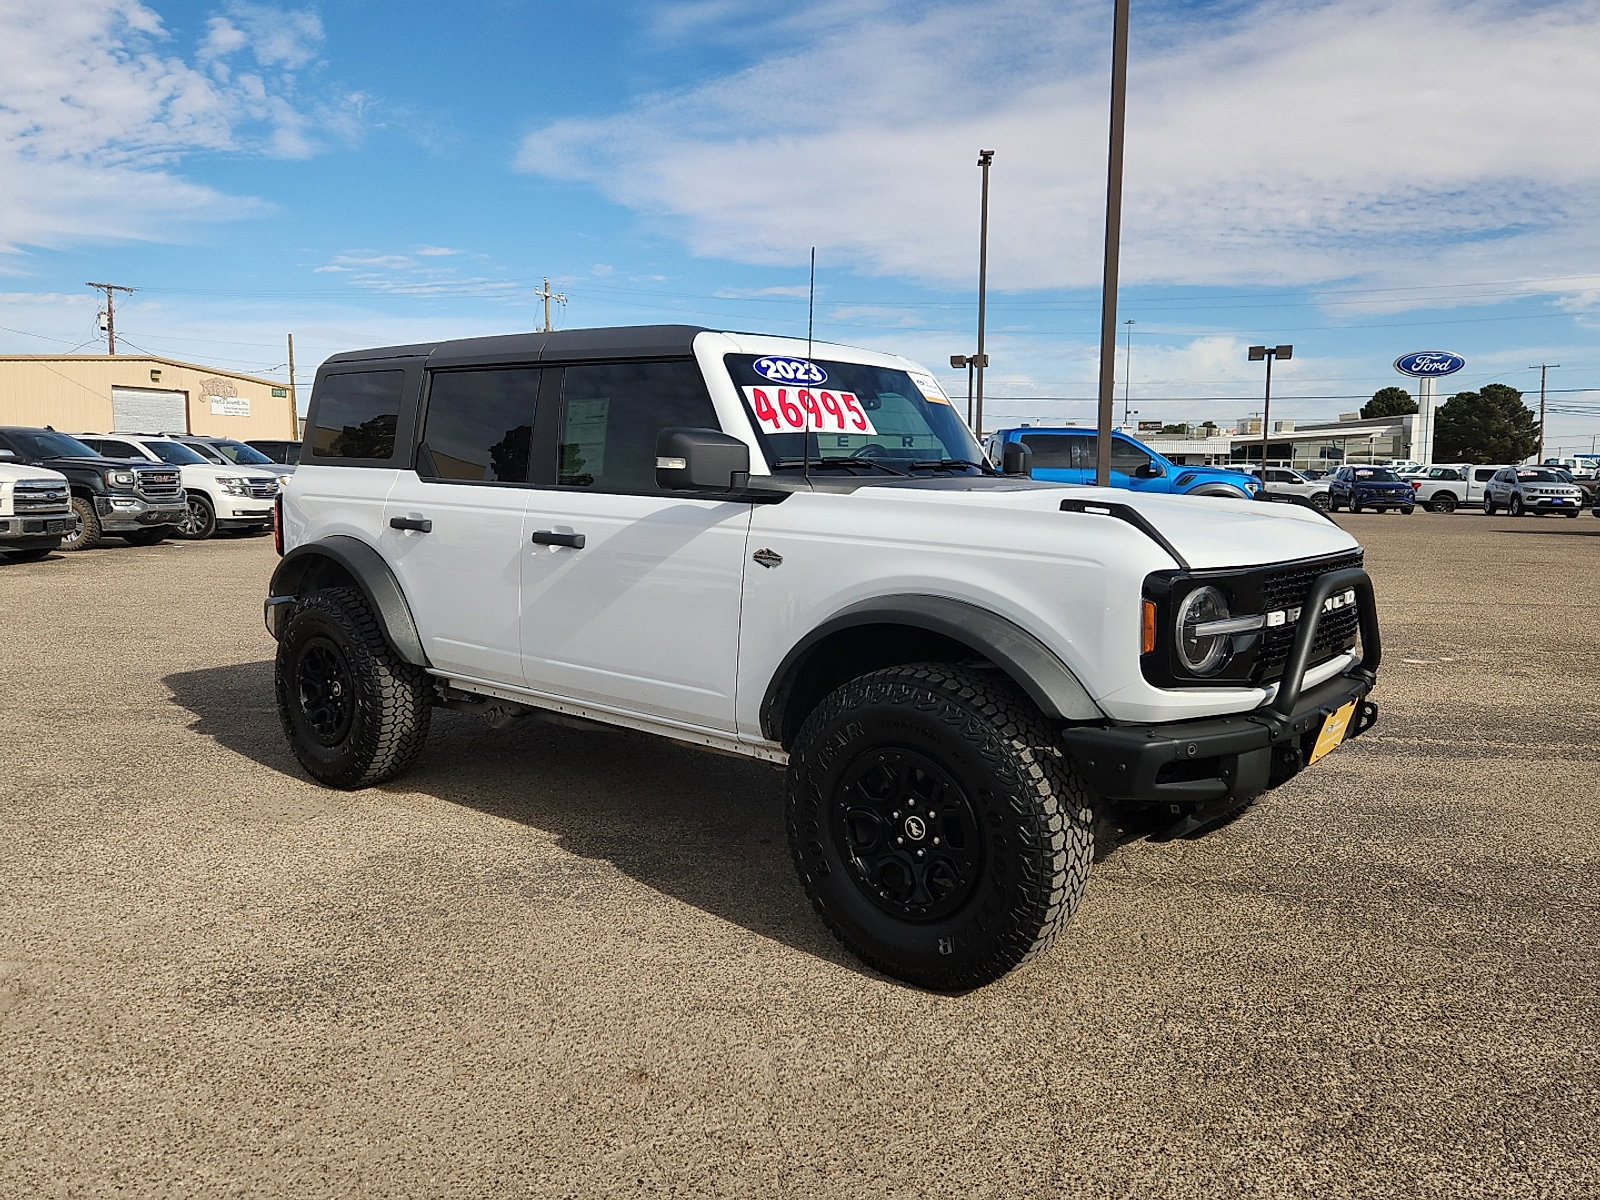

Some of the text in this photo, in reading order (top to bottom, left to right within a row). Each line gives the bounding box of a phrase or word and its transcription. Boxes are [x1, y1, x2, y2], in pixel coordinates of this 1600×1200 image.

[760, 360, 823, 382] 2023
[1411, 355, 1452, 372] Ford
[753, 388, 867, 432] 46995
[1267, 590, 1355, 627] BRNCO
